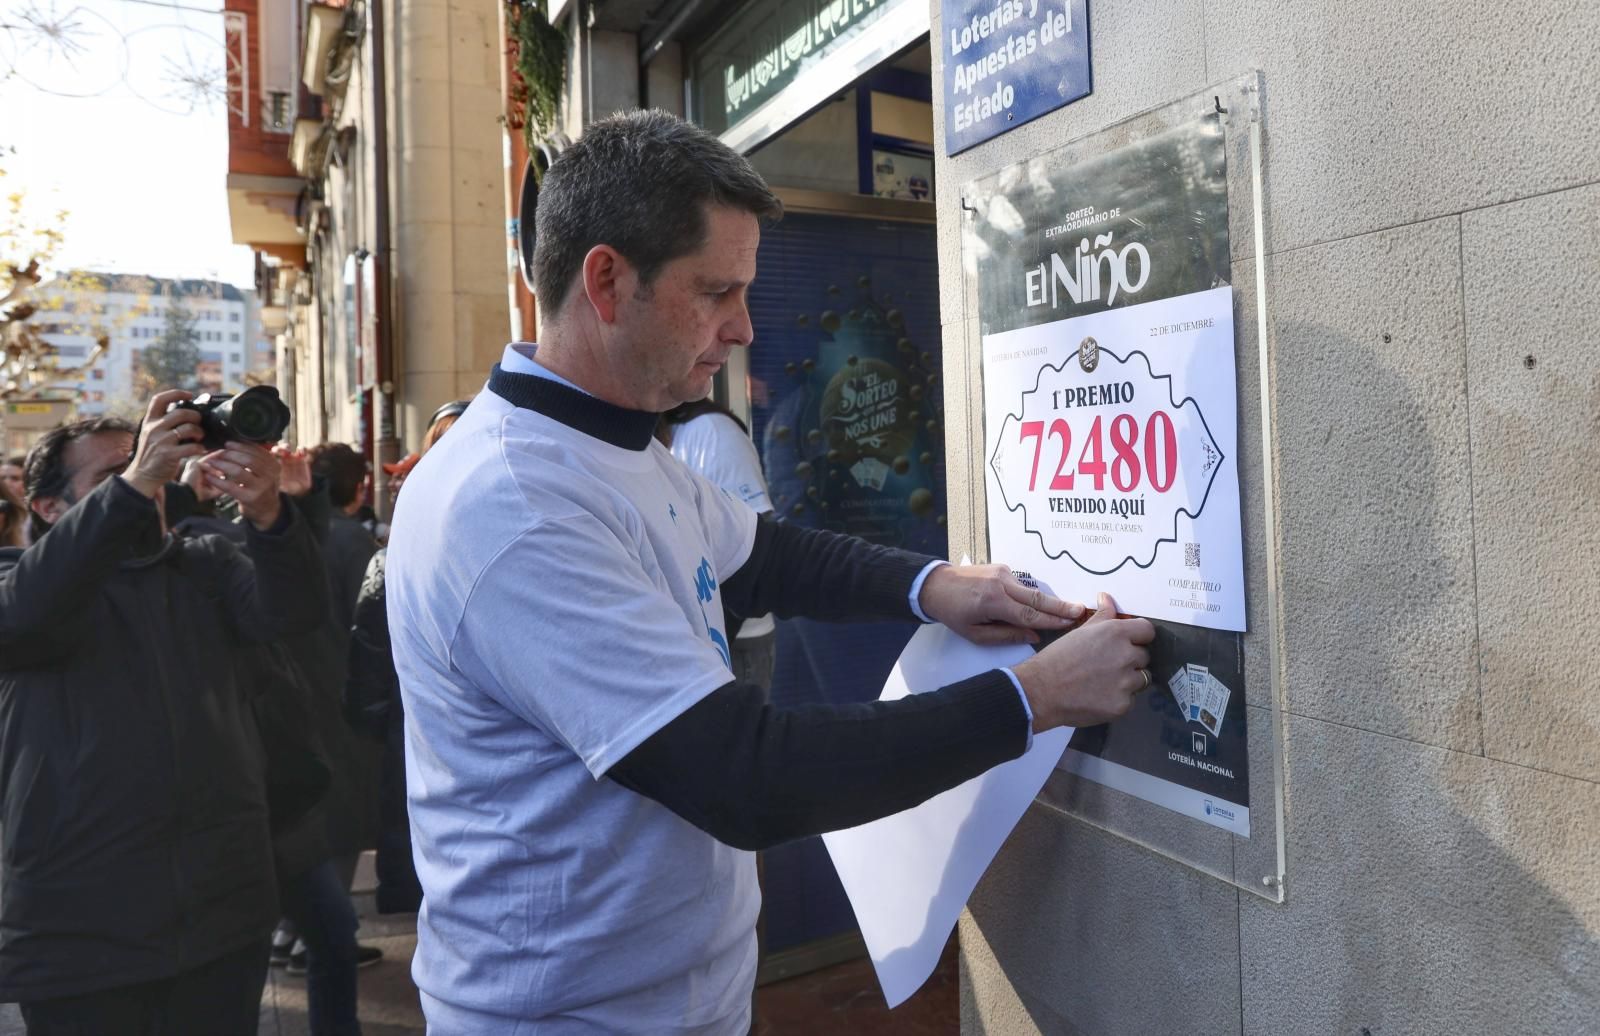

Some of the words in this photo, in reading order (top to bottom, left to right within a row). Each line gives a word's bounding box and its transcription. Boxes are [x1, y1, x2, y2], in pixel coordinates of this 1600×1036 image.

[1029, 0, 1039, 19] y
[953, 29, 1037, 95] Apuestas
[1040, 0, 1072, 46] del
[953, 81, 1014, 133] Estado
[1045, 211, 1108, 238] EXTRAORDINARIO
[1110, 207, 1121, 219] DE
[1065, 205, 1094, 223] SORTEO
[1150, 327, 1158, 337] 22
[1159, 325, 1169, 336] DE
[1171, 317, 1215, 334] DICIEMBRE
[1064, 381, 1135, 409] PREMIO
[844, 419, 868, 441] NOS
[870, 407, 897, 431] UNE
[1019, 410, 1178, 493] 72480
[1048, 497, 1107, 514] VENDIDO
[1110, 493, 1146, 520] AQUÍ
[1080, 534, 1113, 545] LOGROÑO
[1101, 522, 1114, 532] DEL
[1115, 522, 1143, 534] CARMEN
[1168, 577, 1222, 593] COMPARTIRLO
[1197, 760, 1235, 779] NACIONAL
